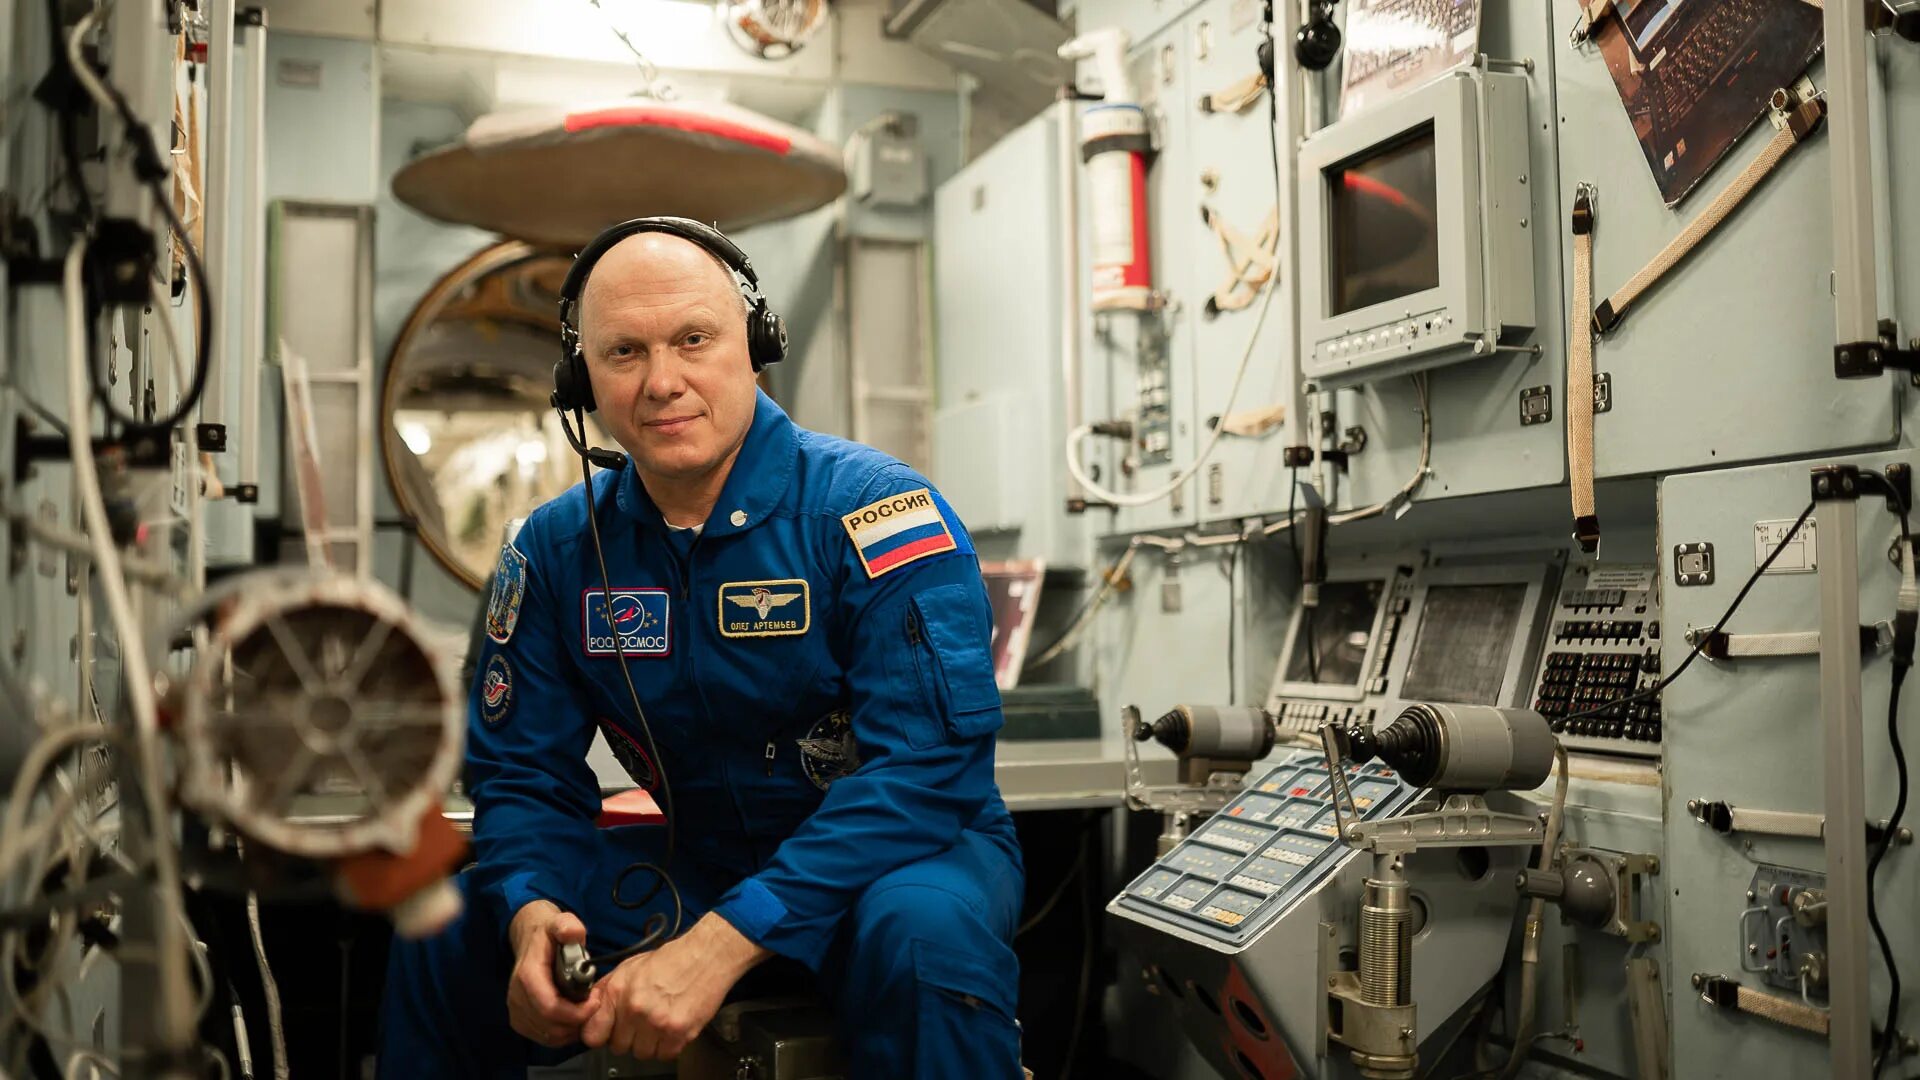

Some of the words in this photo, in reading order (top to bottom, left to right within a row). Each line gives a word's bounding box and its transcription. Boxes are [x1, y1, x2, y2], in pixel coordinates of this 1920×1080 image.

[849, 494, 929, 530] РОССИЯ
[730, 622, 750, 631] ОЛЕГ
[753, 620, 797, 630] АРТЕМЬЕВ
